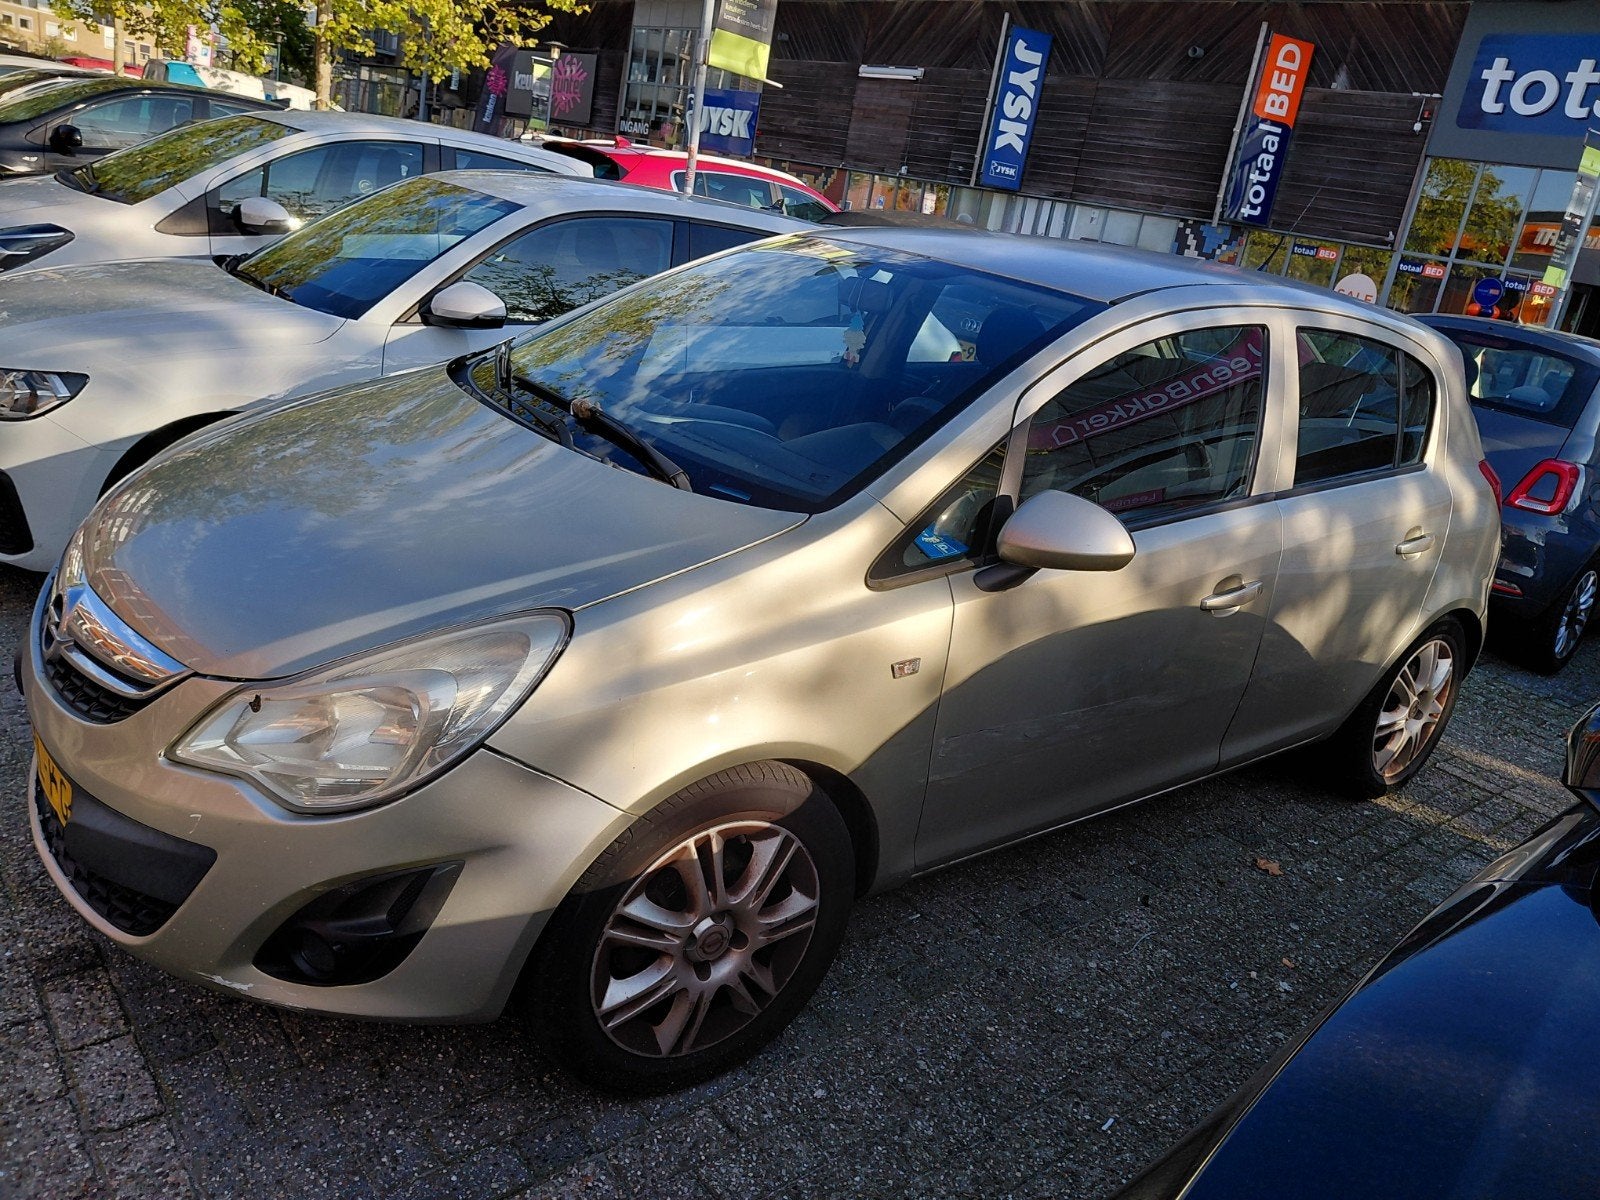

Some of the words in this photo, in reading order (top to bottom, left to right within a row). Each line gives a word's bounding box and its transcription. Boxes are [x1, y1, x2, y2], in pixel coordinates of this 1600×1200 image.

[1481, 57, 1600, 119] tot
[994, 38, 1043, 155] JYSK
[620, 120, 649, 135] INGANG
[699, 106, 753, 139] JYSK
[1240, 123, 1282, 217] totaal
[1263, 43, 1301, 117] BED
[995, 164, 1017, 176] JYSK
[1294, 245, 1317, 256] totaal
[1319, 248, 1337, 259] BED
[1399, 263, 1423, 274] totaal
[1425, 267, 1444, 277] BED
[1534, 284, 1555, 295] BED
